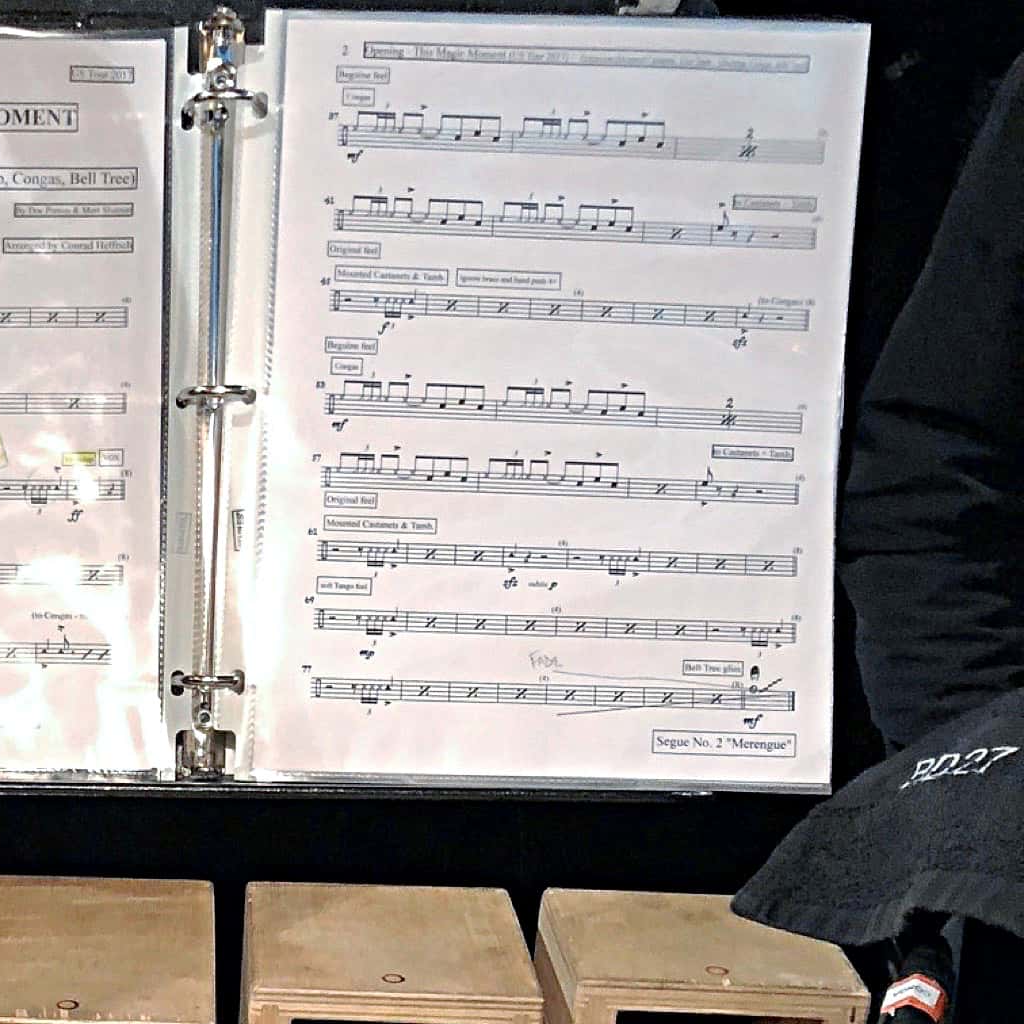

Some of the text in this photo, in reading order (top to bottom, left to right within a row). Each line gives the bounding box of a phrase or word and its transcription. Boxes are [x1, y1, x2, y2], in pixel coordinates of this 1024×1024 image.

[12, 172, 65, 188] Congas,
[70, 172, 96, 185] Bell
[327, 494, 376, 505] Original feel
[327, 519, 360, 529] Mounted
[362, 520, 399, 530] Castanets
[656, 736, 792, 754] Segue No. 2 "Merengue"
